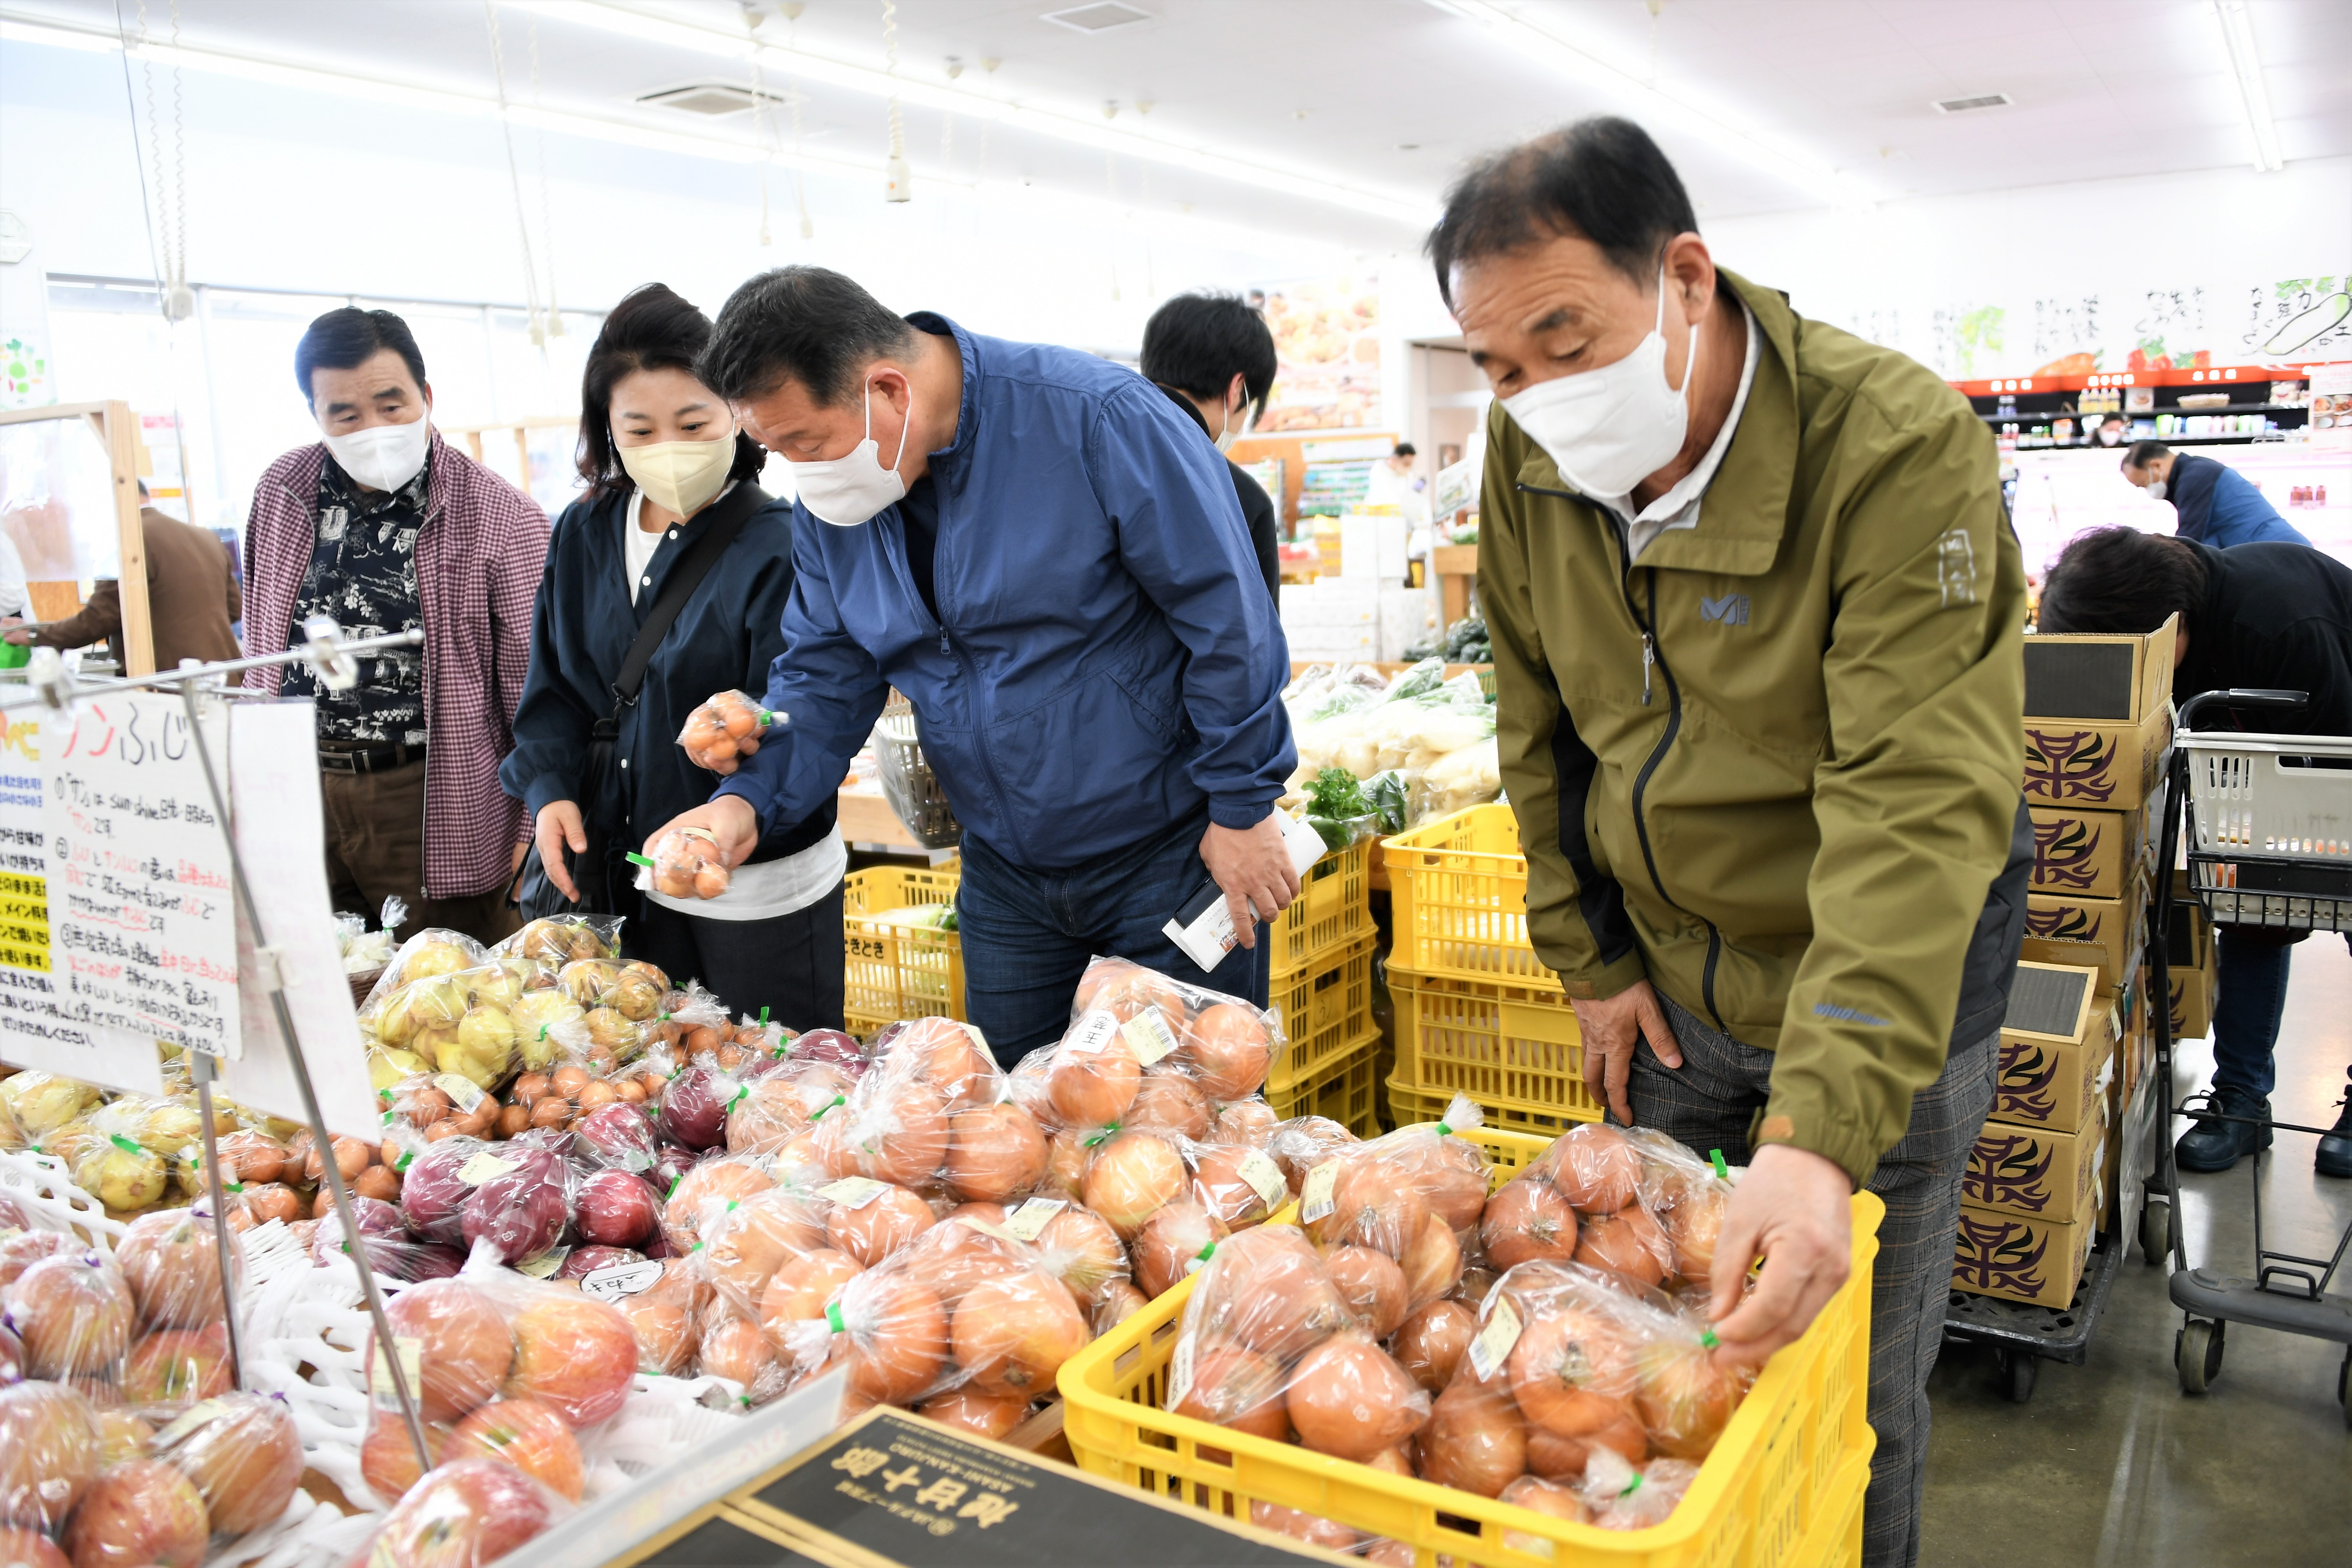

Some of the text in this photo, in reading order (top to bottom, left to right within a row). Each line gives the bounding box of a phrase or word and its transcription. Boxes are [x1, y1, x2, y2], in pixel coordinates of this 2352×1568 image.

[63, 702, 188, 765] ンふじ
[830, 1447, 1020, 1530] 旭甘十郎
